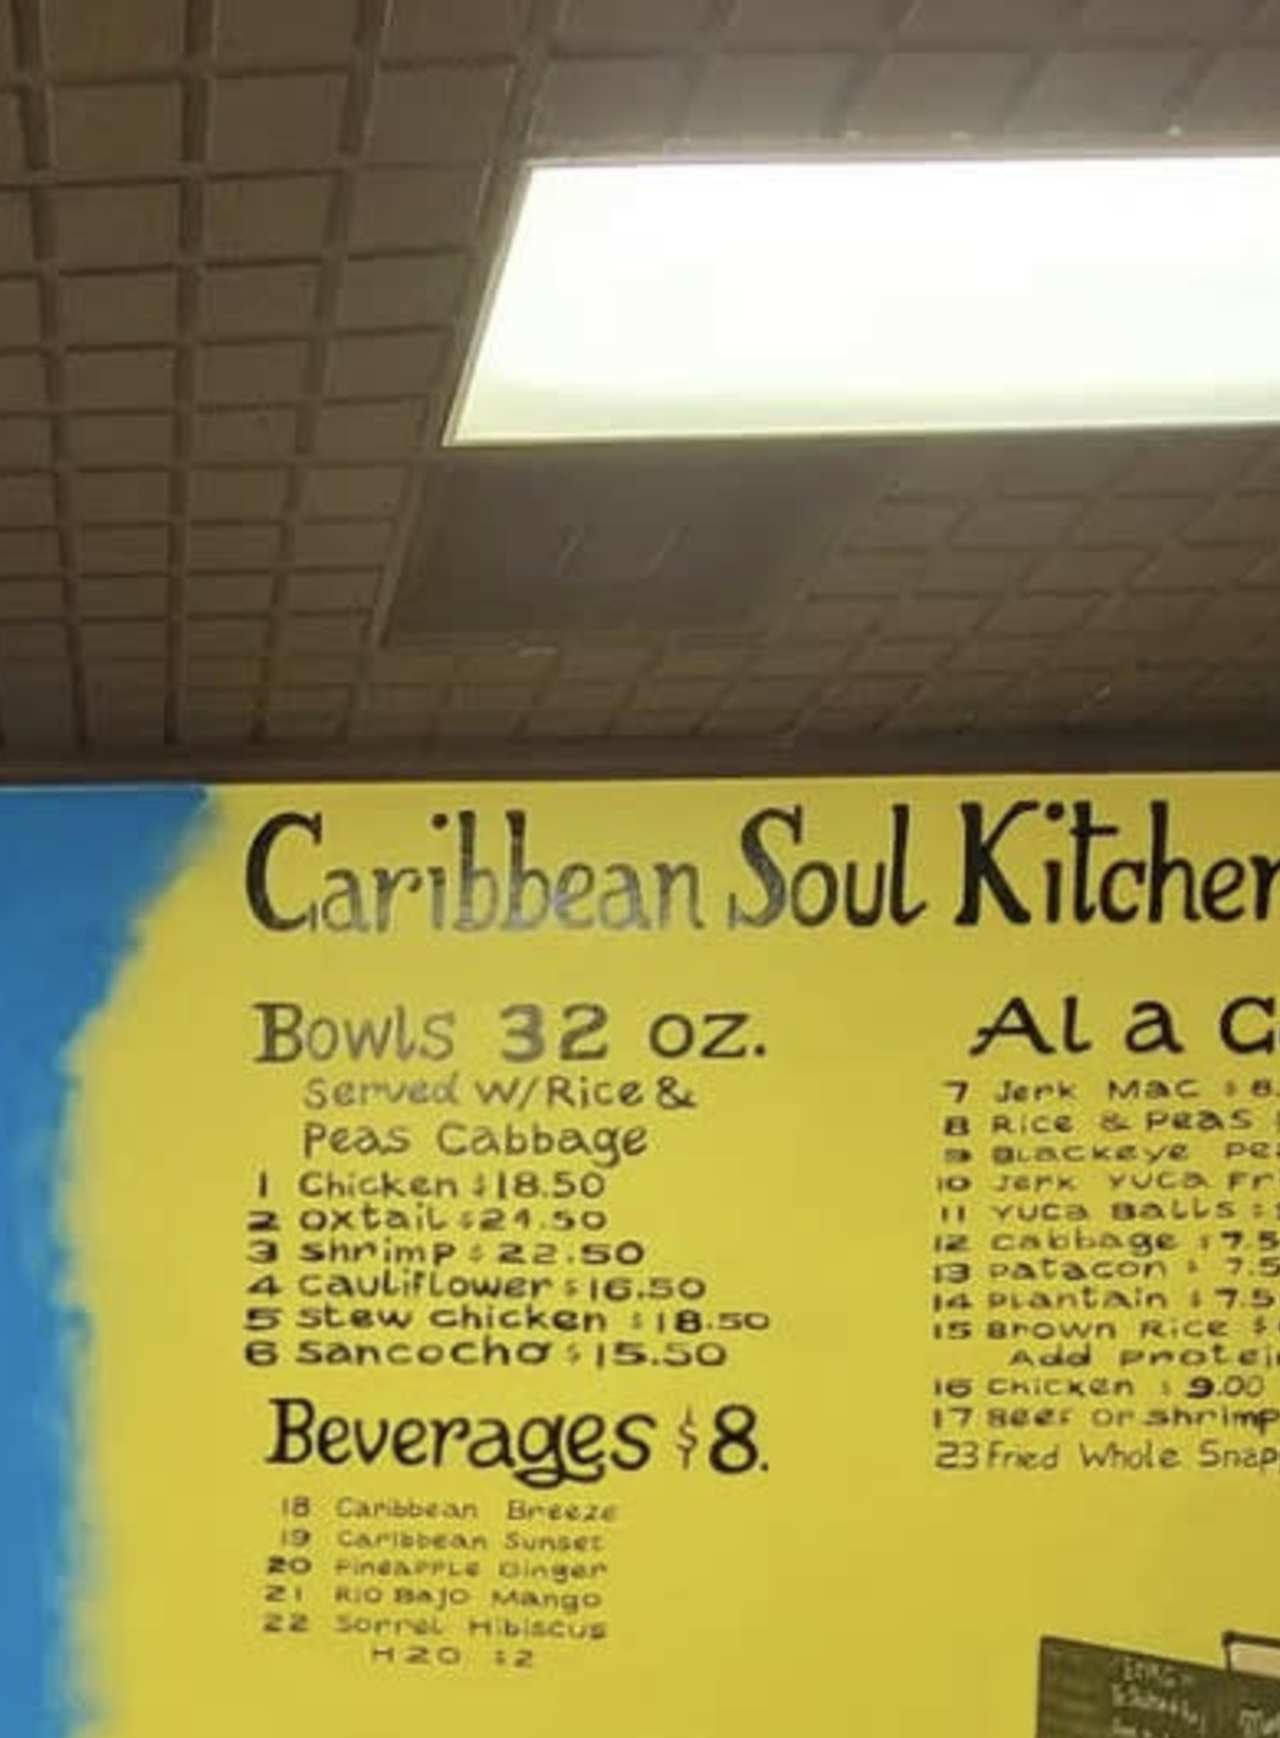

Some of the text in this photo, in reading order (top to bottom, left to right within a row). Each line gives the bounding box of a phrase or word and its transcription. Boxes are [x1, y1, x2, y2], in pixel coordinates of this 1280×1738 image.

[246, 810, 703, 934] Caribbean
[728, 804, 927, 928] Soul
[253, 1002, 455, 1063] Bowls
[500, 1002, 609, 1061] 32
[969, 996, 1092, 1056] Al
[1125, 1000, 1186, 1054] a
[303, 1075, 459, 1109] Served
[656, 1076, 697, 1108] &
[943, 1080, 968, 1103] 7
[994, 1079, 1075, 1103] Jerk
[944, 1115, 970, 1136] 8
[991, 1114, 1073, 1134] Rice
[1100, 1114, 1131, 1132] &
[303, 1121, 649, 1167] Peas Cabbage
[944, 1148, 971, 1163] 9
[259, 1171, 268, 1198] 1
[298, 1171, 458, 1198] Chicken
[937, 1176, 970, 1193] 10
[994, 1175, 1076, 1193] Jerk
[247, 1210, 281, 1231] 2
[941, 1205, 966, 1223] 11
[247, 1240, 278, 1264] 3
[934, 1234, 969, 1252] 12
[247, 1274, 281, 1296] 4
[934, 1263, 970, 1284] 13
[933, 1293, 971, 1312] 14
[244, 1307, 282, 1330] 5
[934, 1322, 971, 1340] 15
[1140, 1318, 1228, 1339] Rice
[245, 1341, 279, 1366] 6
[1010, 1344, 1091, 1367] Add
[934, 1379, 972, 1399] 16
[933, 1407, 972, 1430] 17
[265, 1397, 658, 1488] Beverages
[935, 1440, 978, 1469] 23
[986, 1440, 1059, 1470] Fried
[1080, 1440, 1181, 1470] Whole
[281, 1497, 617, 1521] 18 Caribbean Breeze
[281, 1530, 605, 1551] 19 Caribbean Sunset
[267, 1556, 312, 1575] 20
[264, 1585, 303, 1602] 21
[492, 1588, 602, 1615] Mango
[263, 1613, 310, 1633] 22
[469, 1617, 607, 1640] Hibiscus
